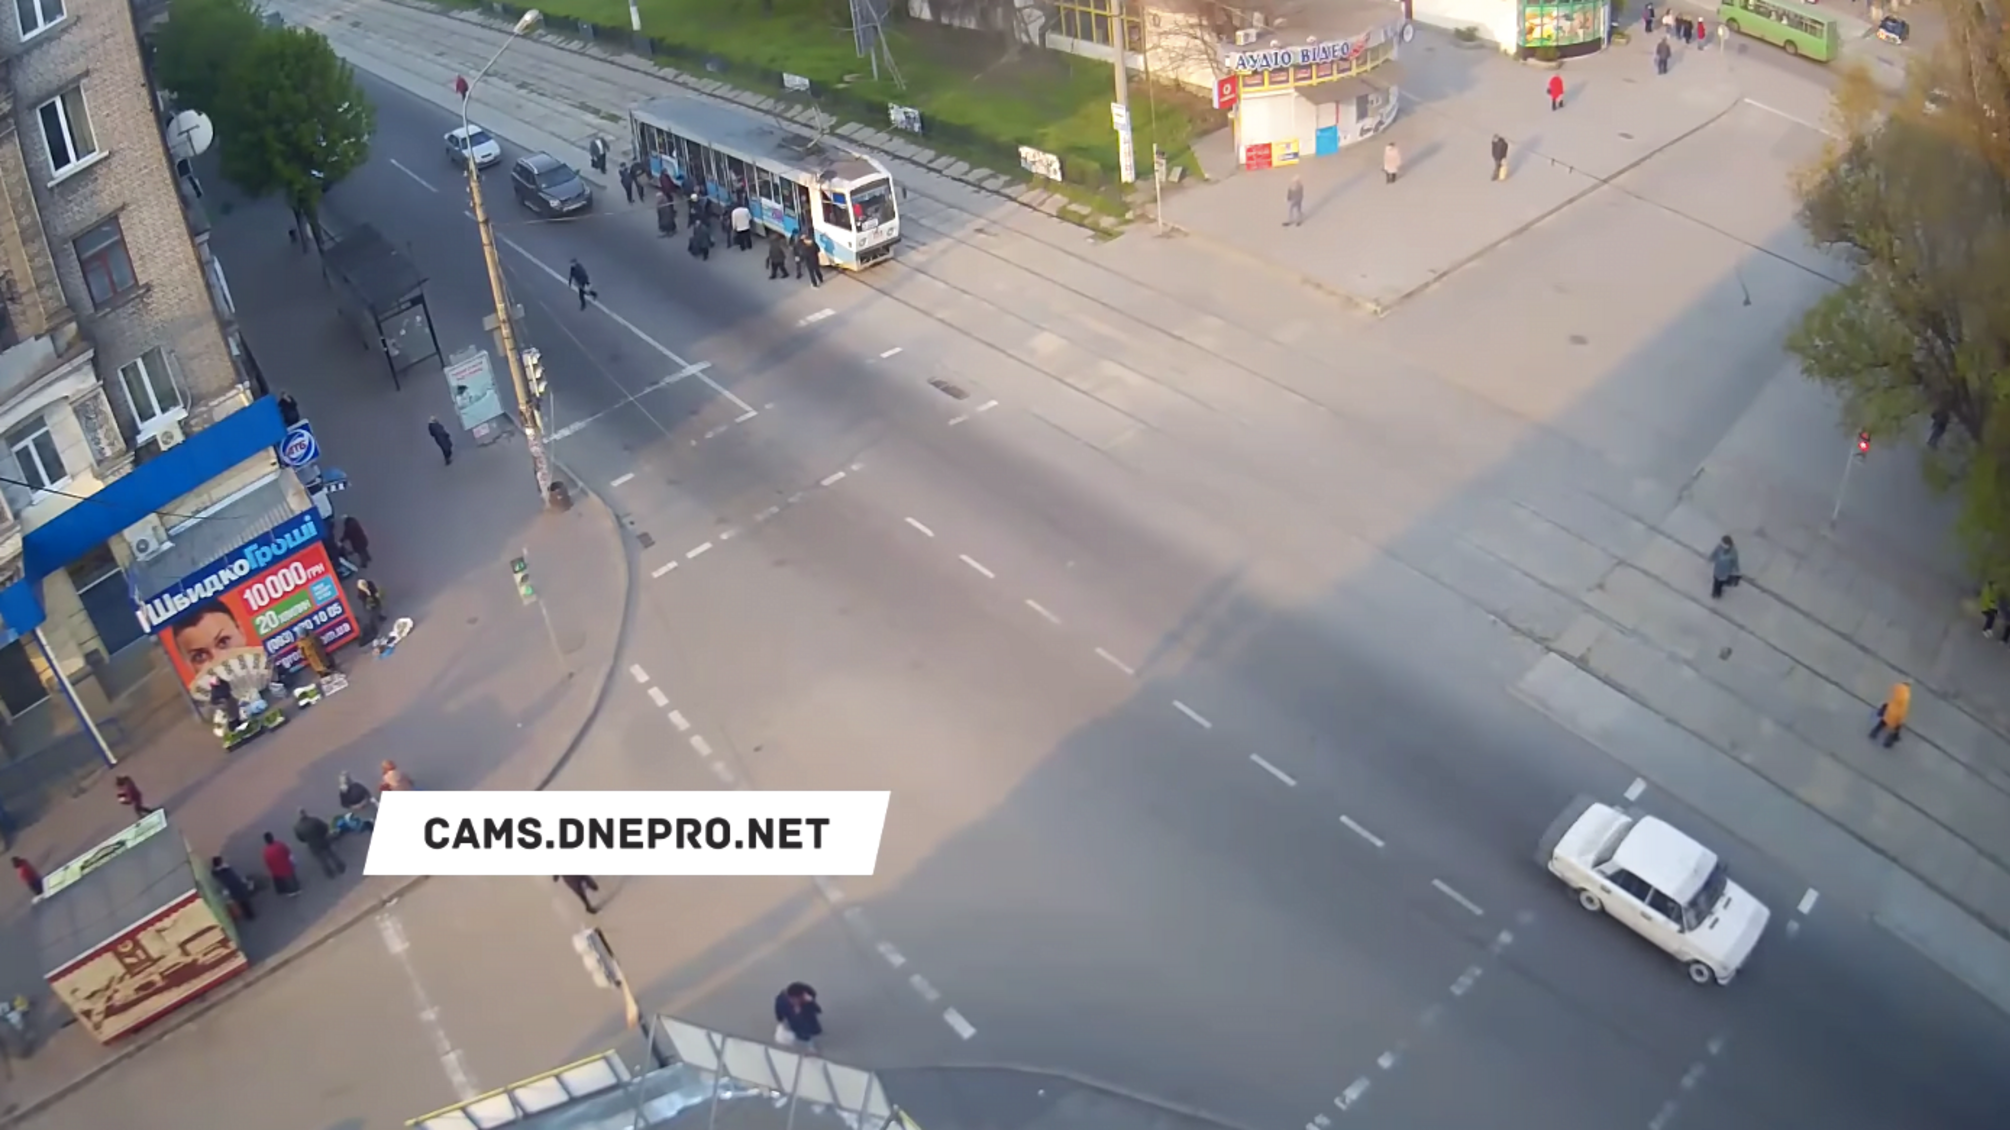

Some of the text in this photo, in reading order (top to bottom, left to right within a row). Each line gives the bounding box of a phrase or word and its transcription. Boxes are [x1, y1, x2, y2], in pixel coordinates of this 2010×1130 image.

[1236, 42, 1350, 69] АУДІО ВІДЕО
[147, 514, 318, 627] ШвидкоГроші
[243, 561, 308, 611] 10000
[255, 610, 279, 635] 20
[312, 610, 328, 625] 10
